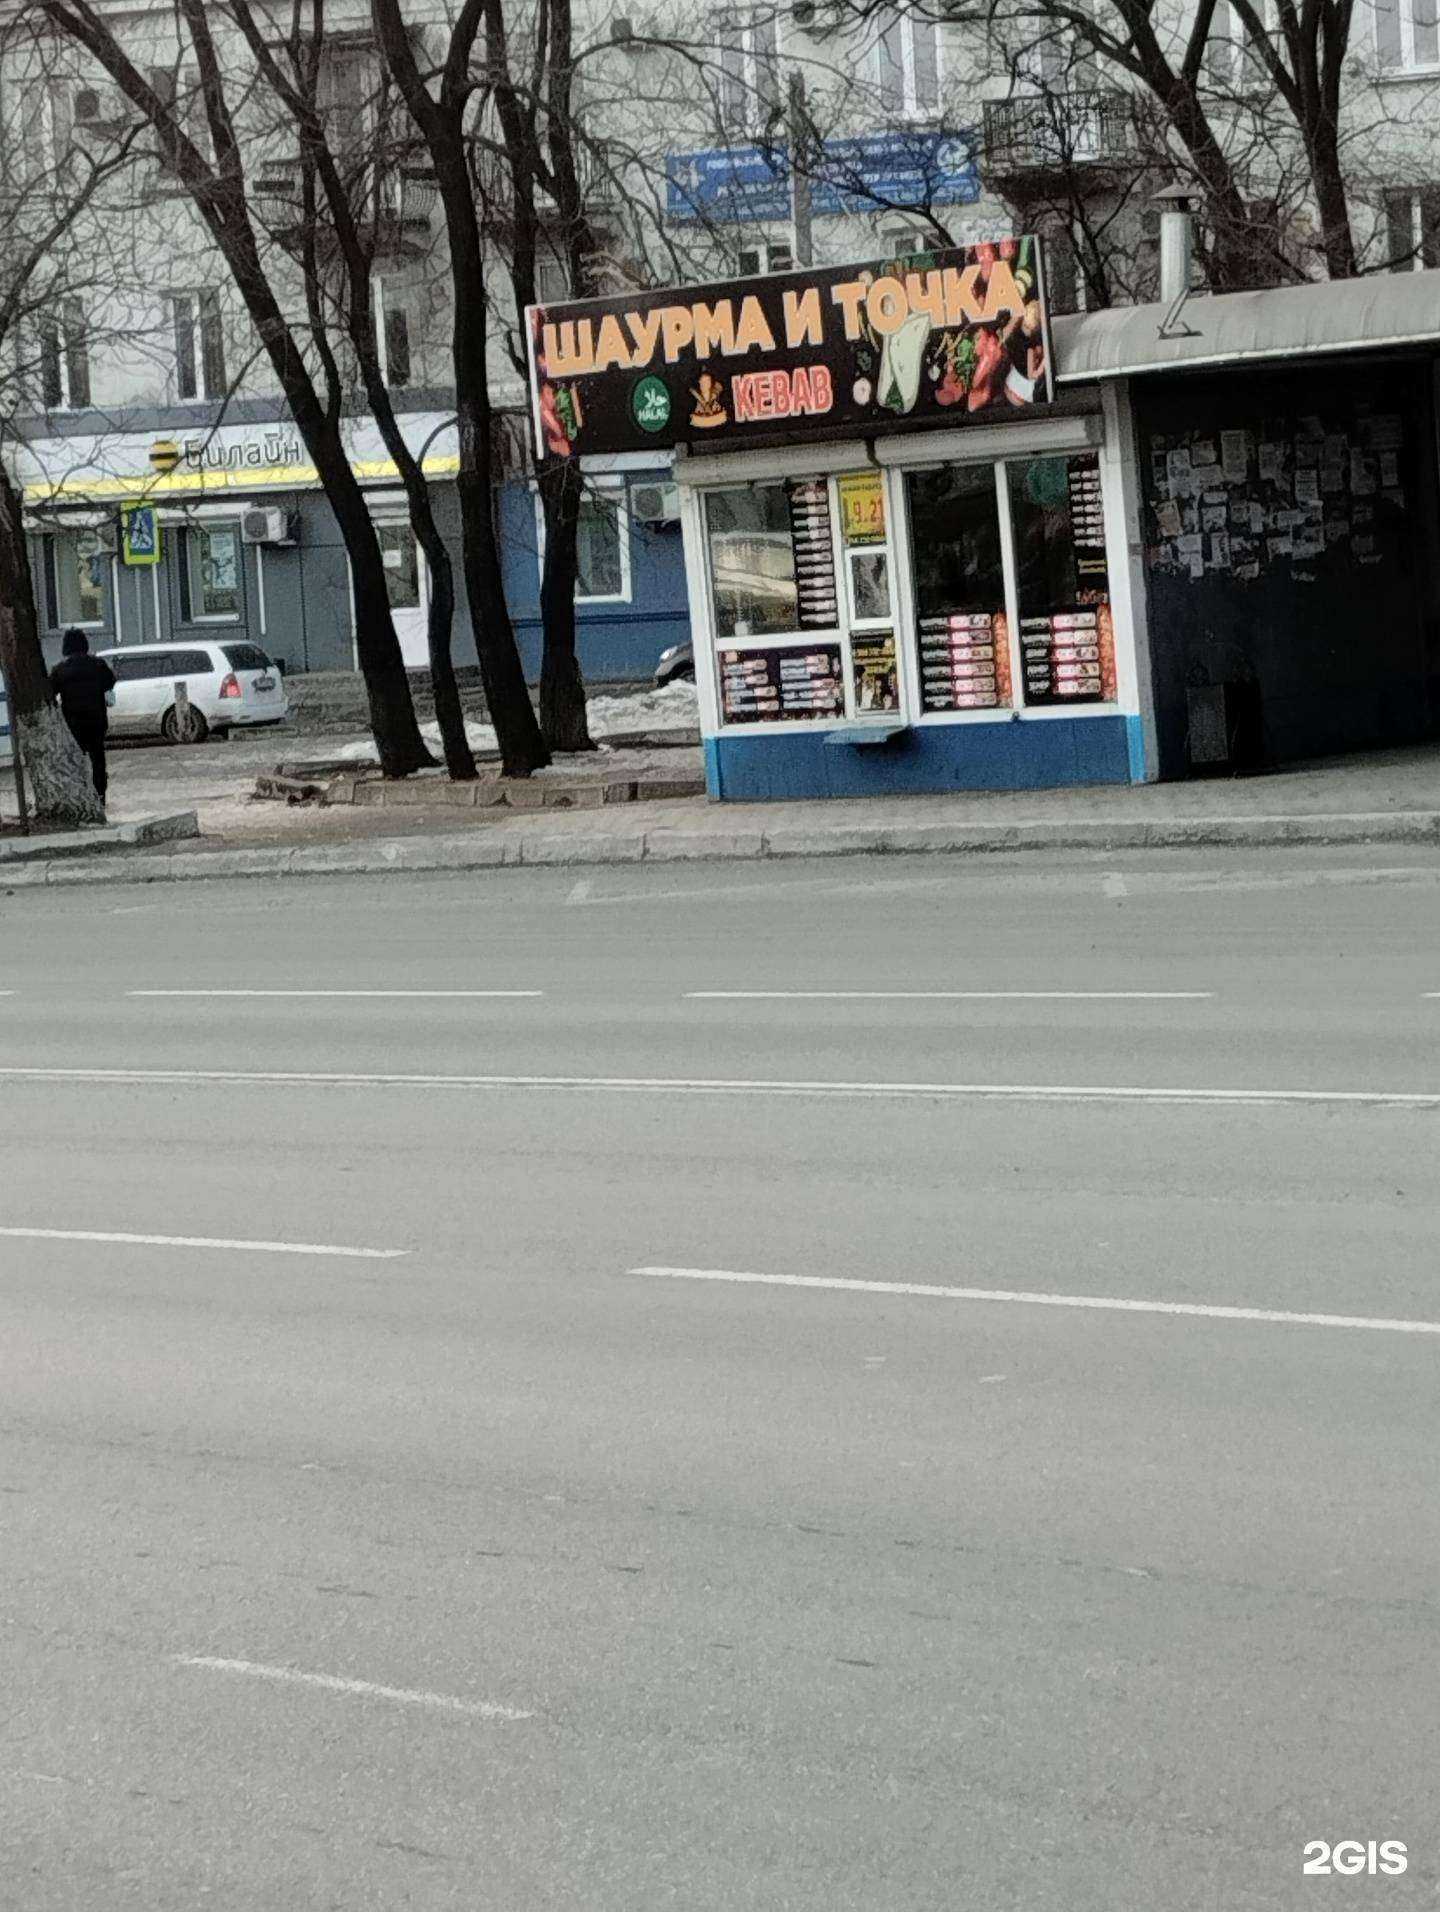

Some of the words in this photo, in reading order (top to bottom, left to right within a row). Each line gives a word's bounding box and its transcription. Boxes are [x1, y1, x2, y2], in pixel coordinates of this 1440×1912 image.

[543, 295, 776, 378] ШАУРМА
[783, 288, 824, 348] И
[831, 260, 1025, 341] ТОЧКА
[731, 365, 834, 423] KEBAB
[185, 432, 300, 469] Билайн
